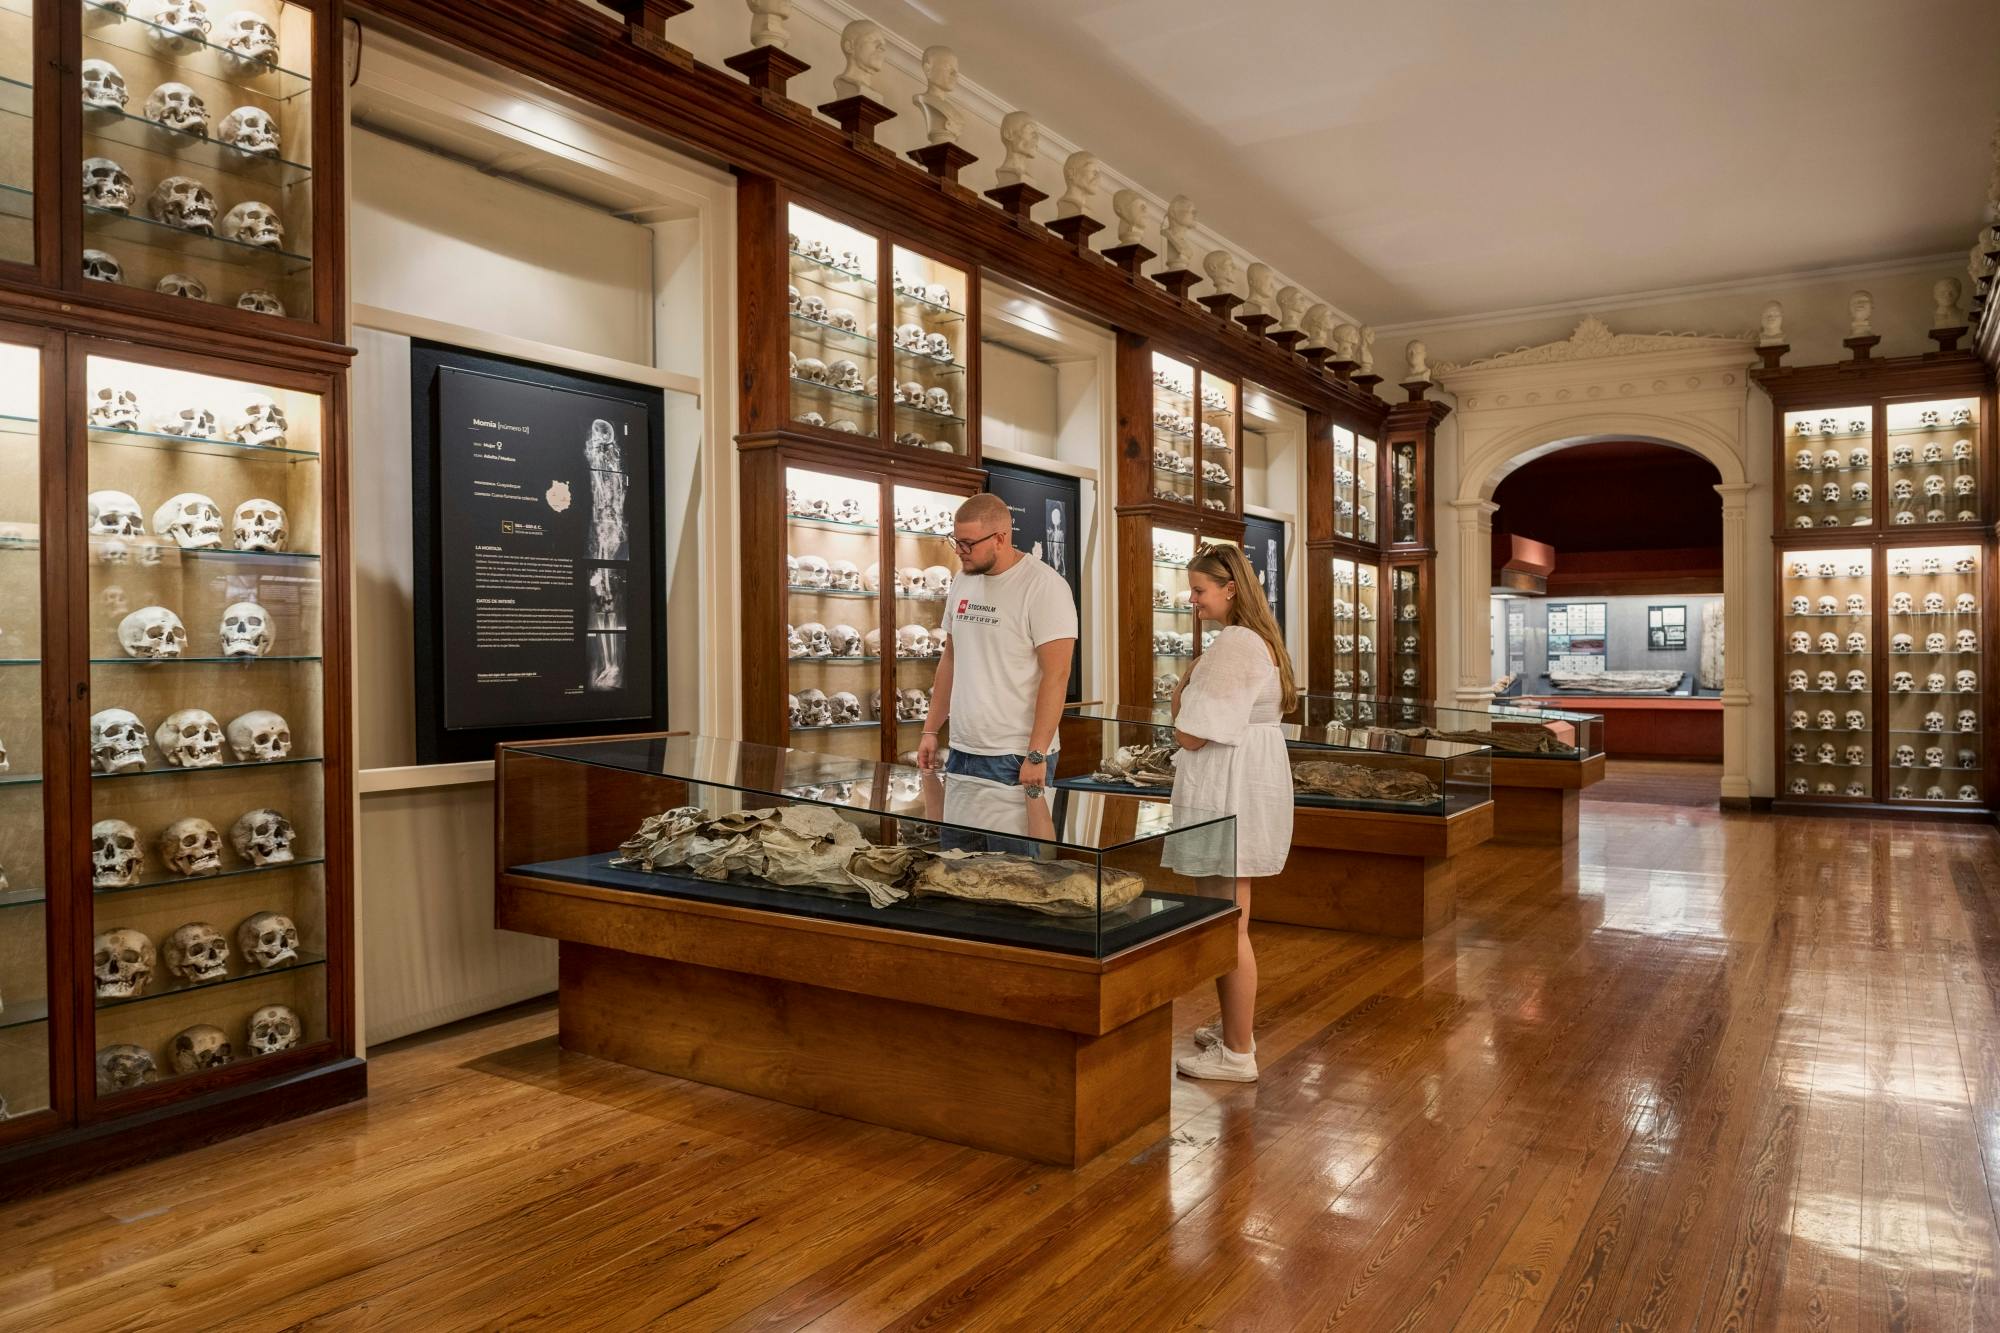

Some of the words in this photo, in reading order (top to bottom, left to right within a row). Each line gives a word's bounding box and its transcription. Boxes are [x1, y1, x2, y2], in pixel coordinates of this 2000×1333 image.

[473, 418, 497, 428] Momia
[498, 421, 521, 431] [número
[968, 604, 996, 612] STOCKHOLM
